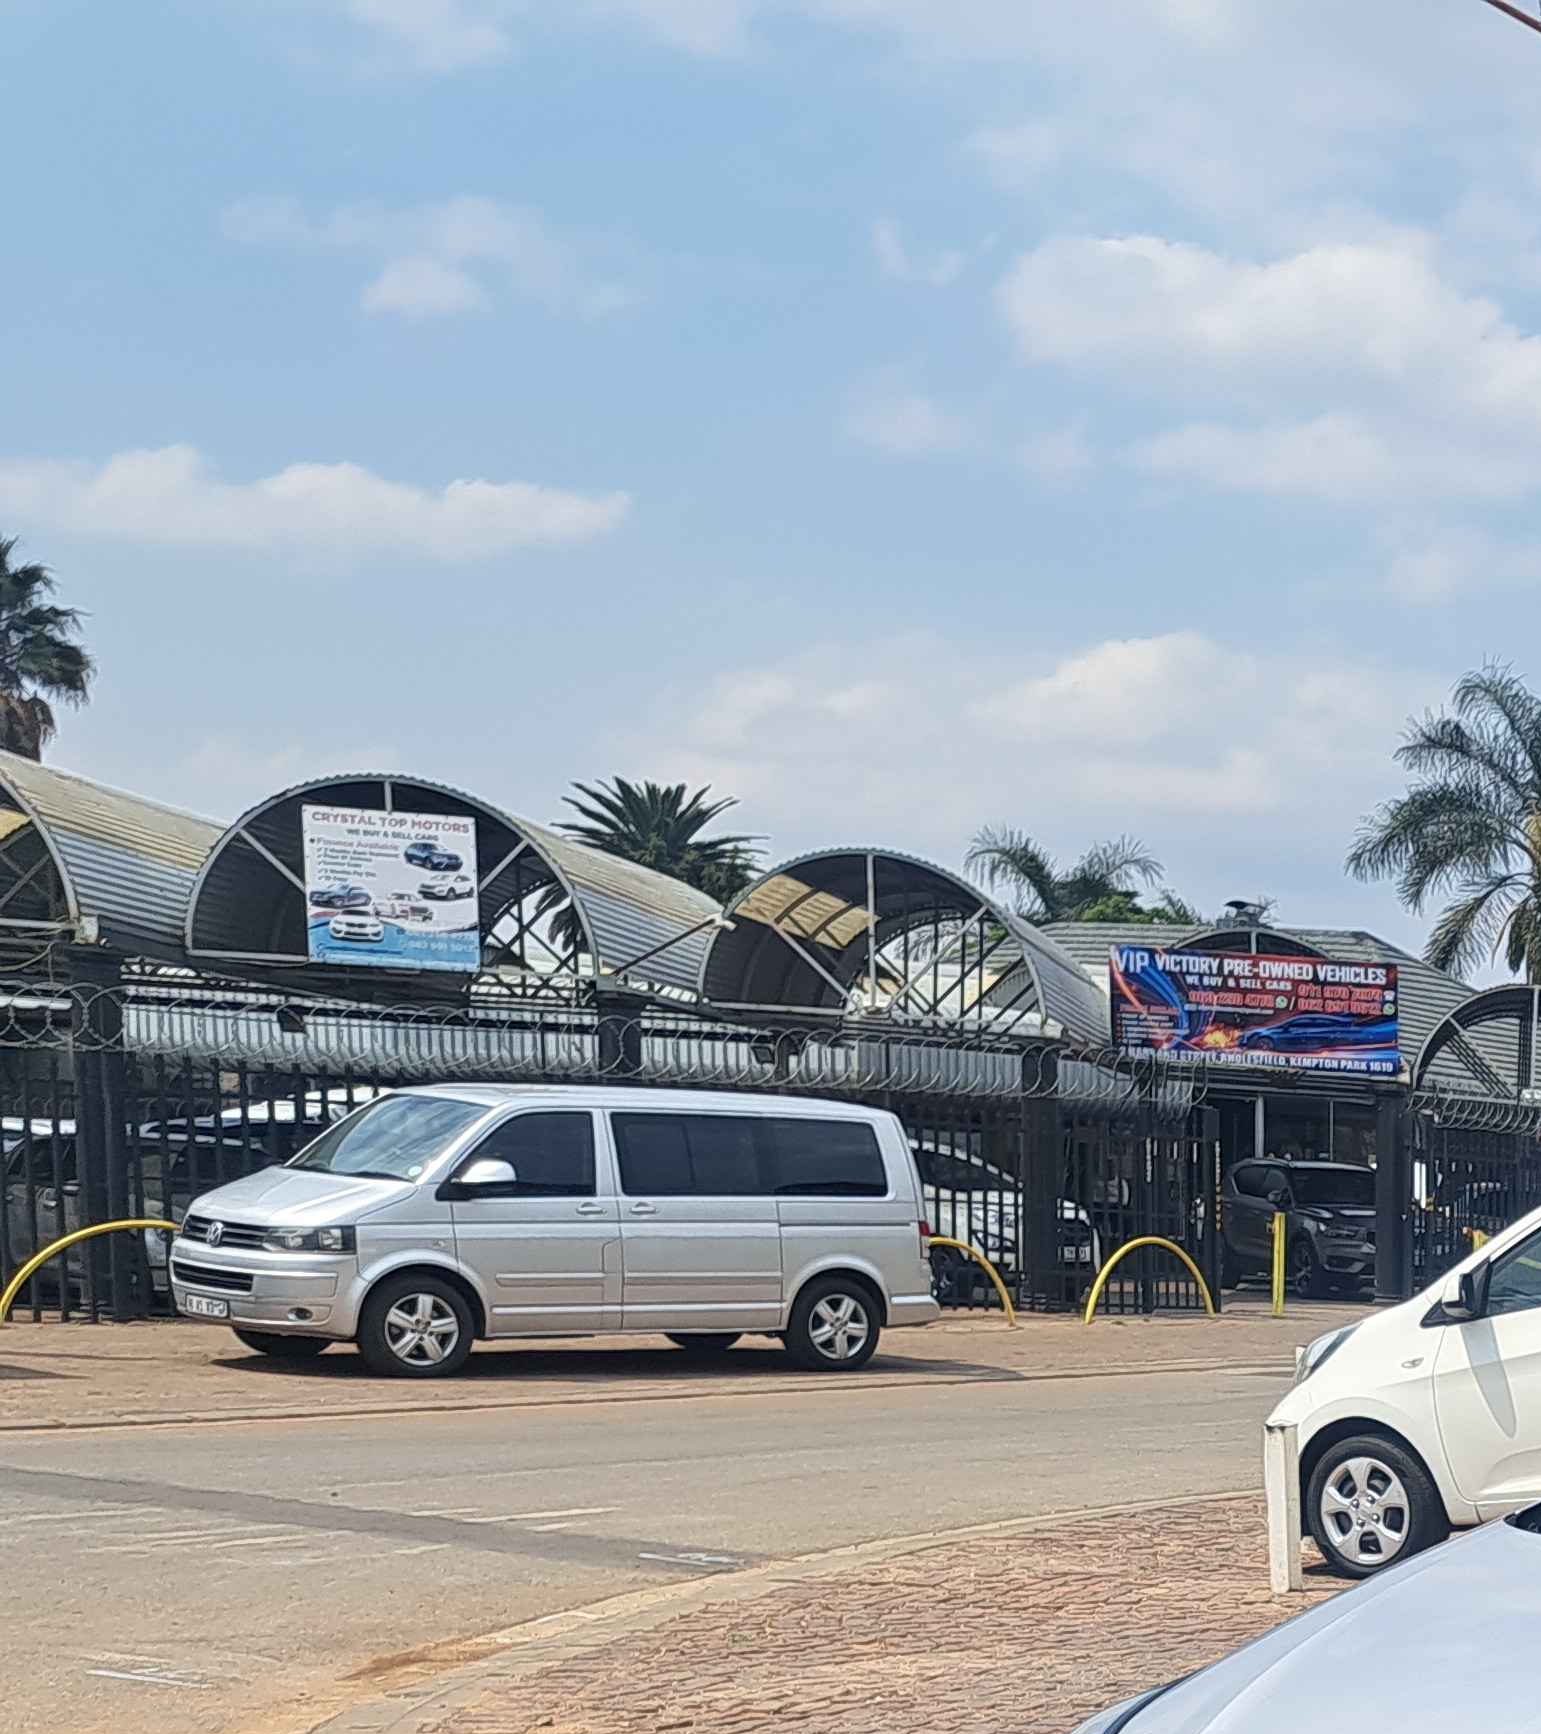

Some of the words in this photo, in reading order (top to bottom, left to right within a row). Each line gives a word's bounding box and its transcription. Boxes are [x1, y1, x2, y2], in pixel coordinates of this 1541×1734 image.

[311, 811, 376, 827] CRYSTAL
[379, 816, 408, 829] TOP
[411, 820, 470, 834] MOTORS
[1119, 949, 1150, 974] VIP
[1155, 953, 1220, 975] VICTORY
[1223, 958, 1313, 981] PRE-OWNED
[1316, 964, 1387, 986] VEHICLES
[1184, 975, 1200, 986] WE
[1202, 976, 1223, 987] BUY
[1340, 1059, 1367, 1071] PARK
